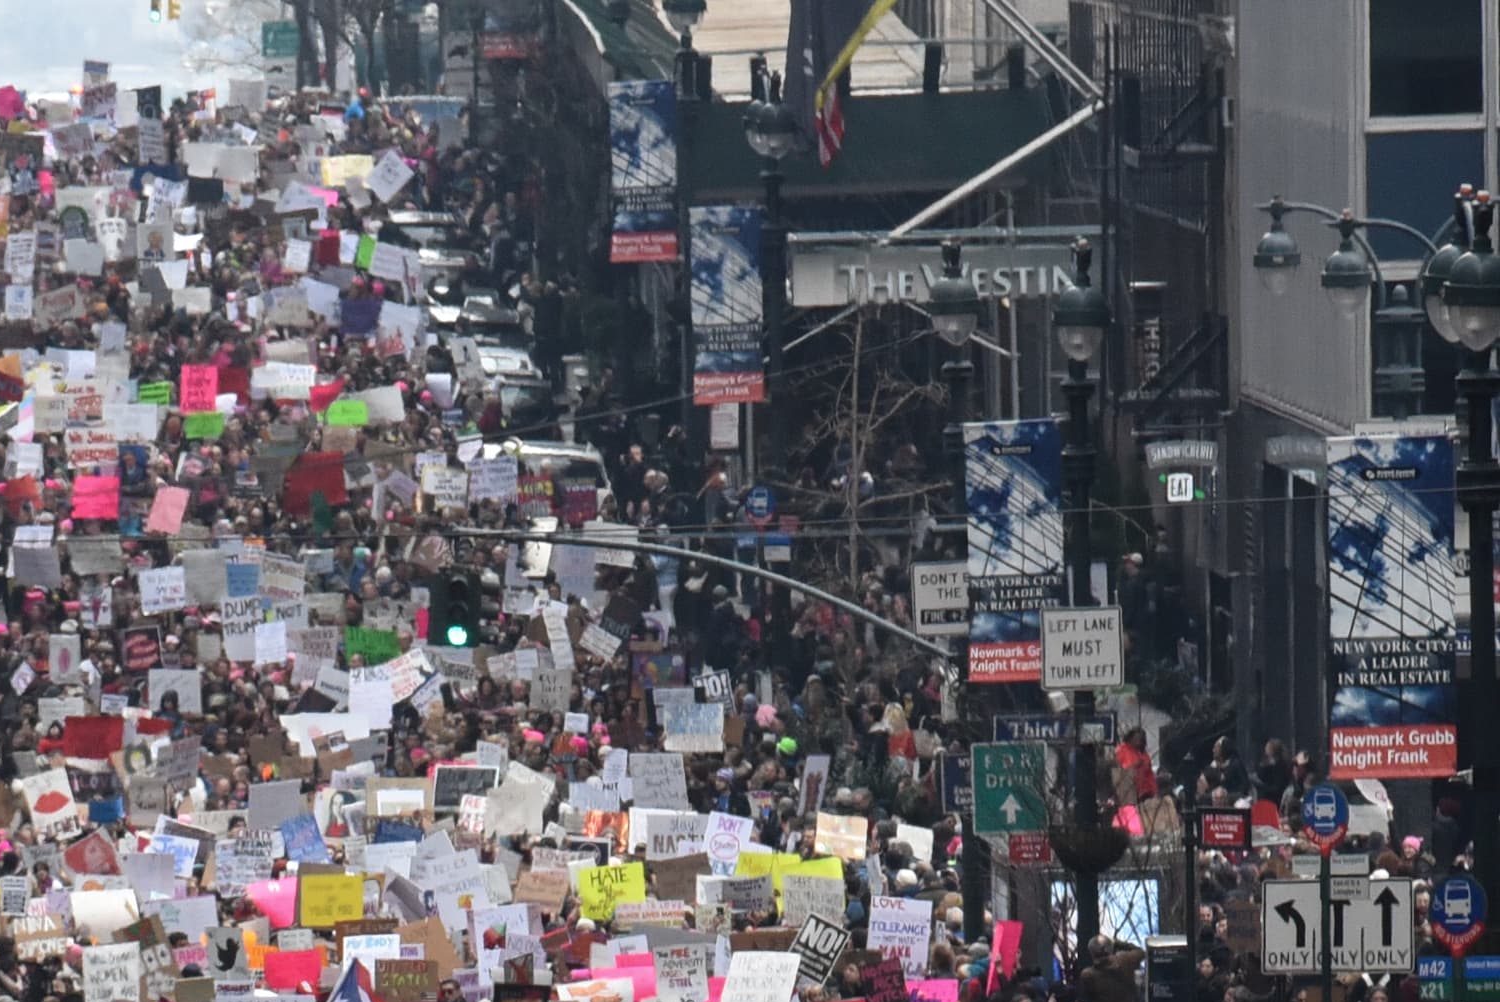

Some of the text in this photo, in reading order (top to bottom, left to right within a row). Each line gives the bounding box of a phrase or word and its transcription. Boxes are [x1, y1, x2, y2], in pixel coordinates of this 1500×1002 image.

[839, 264, 916, 300] THE
[1170, 477, 1190, 497] EAT
[920, 572, 958, 586] DON'T
[996, 576, 1023, 588] YORK
[937, 587, 959, 599] THE
[989, 587, 1042, 599] A LEADER
[974, 598, 1061, 611] IN REAL ESTATE
[1048, 618, 1113, 633] LEFT LANE
[969, 645, 1024, 660] Newmark
[1062, 639, 1103, 657] MUST
[1333, 641, 1361, 655] NEW
[1370, 640, 1410, 653] YORK
[969, 659, 1007, 674] Knight
[1359, 655, 1428, 670] A LEADER
[1051, 664, 1116, 680] TURN LEFT
[1337, 670, 1451, 686] IN REAL ESTATE
[1011, 721, 1059, 738] Third
[1332, 729, 1455, 747] Newmark Grubb
[1332, 748, 1429, 768] Knight Frank
[590, 866, 628, 886] HATE
[800, 917, 849, 960] NO!
[1267, 950, 1407, 967] ONLY ONLY
